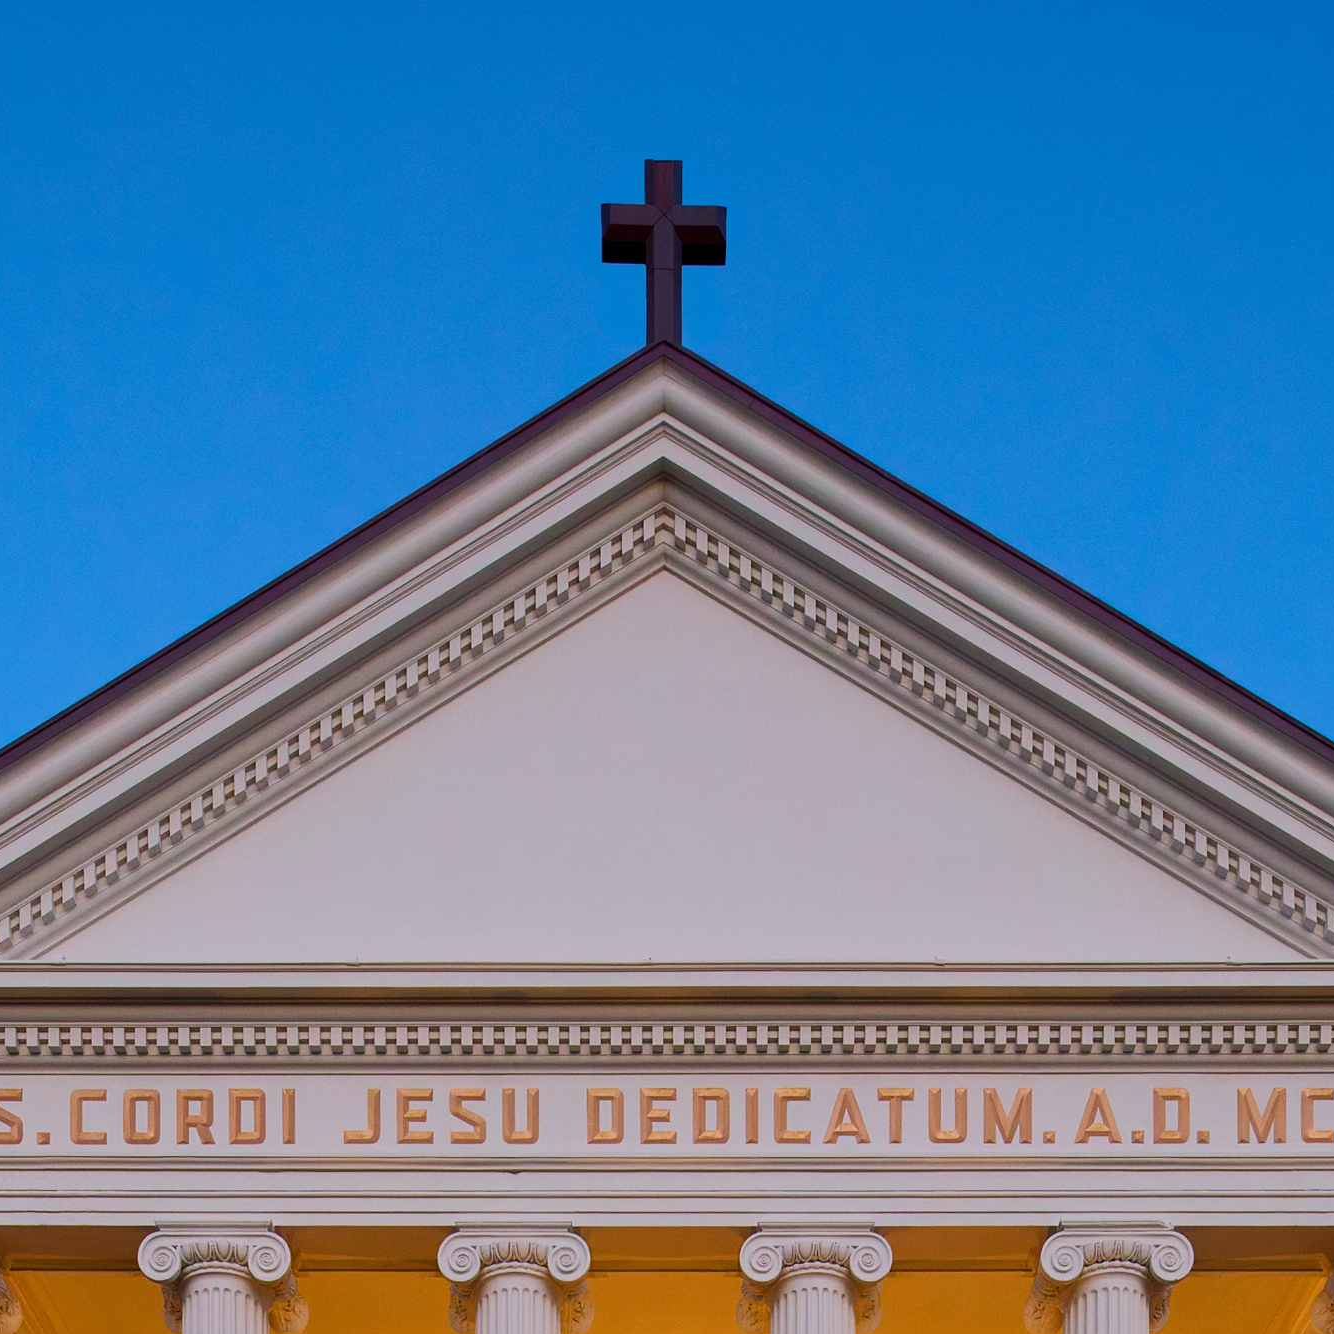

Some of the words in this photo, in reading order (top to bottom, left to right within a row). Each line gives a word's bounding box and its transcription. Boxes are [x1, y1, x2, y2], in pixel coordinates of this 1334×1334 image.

[343, 1087, 540, 1145] JESU
[586, 1087, 1056, 1145] DEDICATUM.
[1073, 1087, 1210, 1145] A.D.
